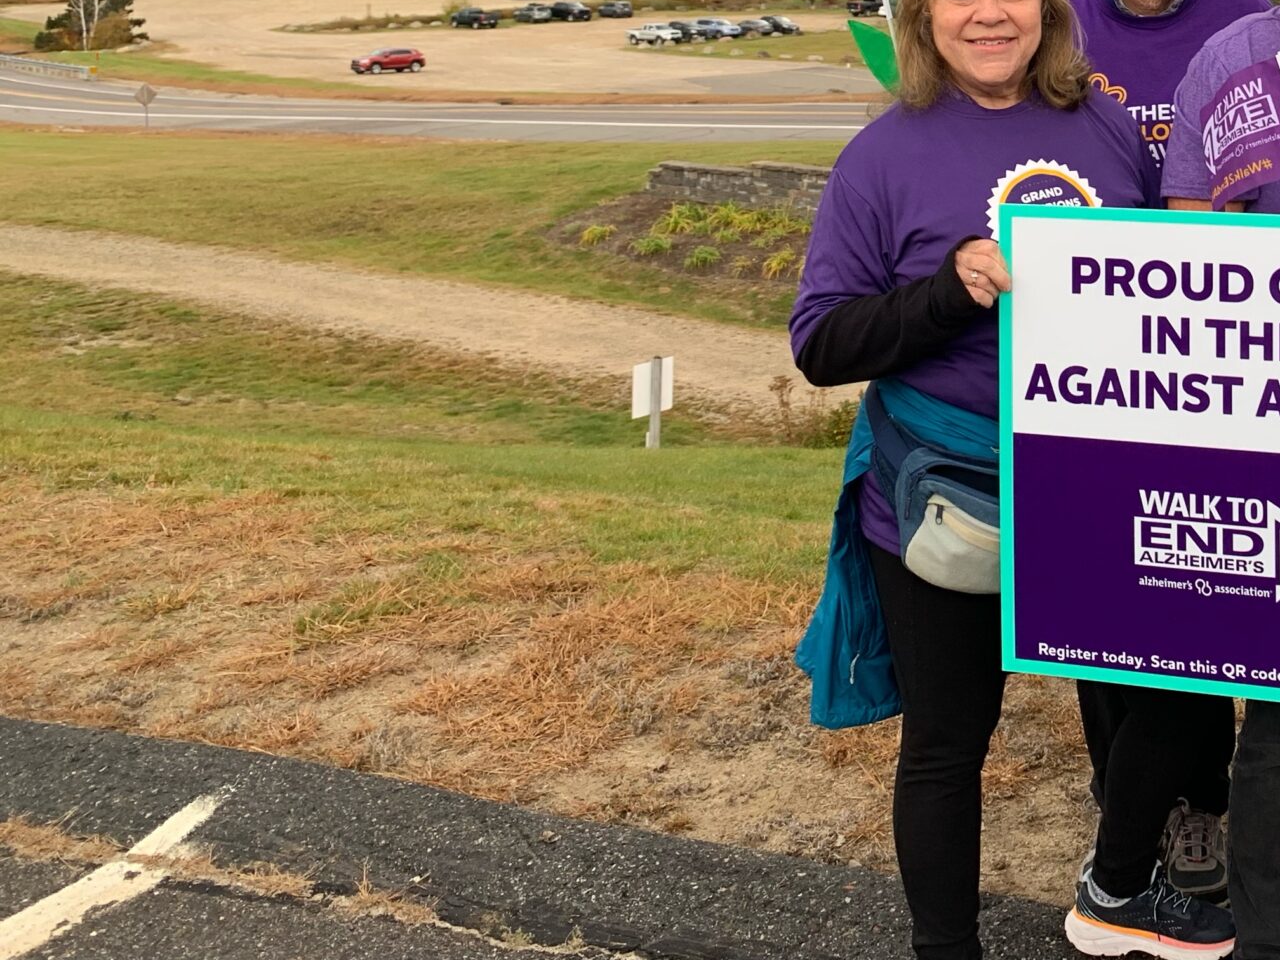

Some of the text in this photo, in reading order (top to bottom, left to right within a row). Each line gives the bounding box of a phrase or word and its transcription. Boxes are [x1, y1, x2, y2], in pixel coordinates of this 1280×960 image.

[1020, 186, 1063, 204] GRAND
[1071, 256, 1254, 303] PROUD
[1141, 315, 1190, 356] IN
[1024, 363, 1244, 415] AGAINST
[1138, 488, 1264, 524] WALK TO
[1140, 520, 1265, 557] END
[1139, 550, 1265, 574] ALZHEIMER'S
[1138, 575, 1271, 598] alzheimer's association
[1038, 642, 1098, 661] Register
[1102, 650, 1147, 669] today.
[1150, 654, 1185, 671] Scan
[1189, 660, 1218, 675] this
[1221, 662, 1247, 679] QR
